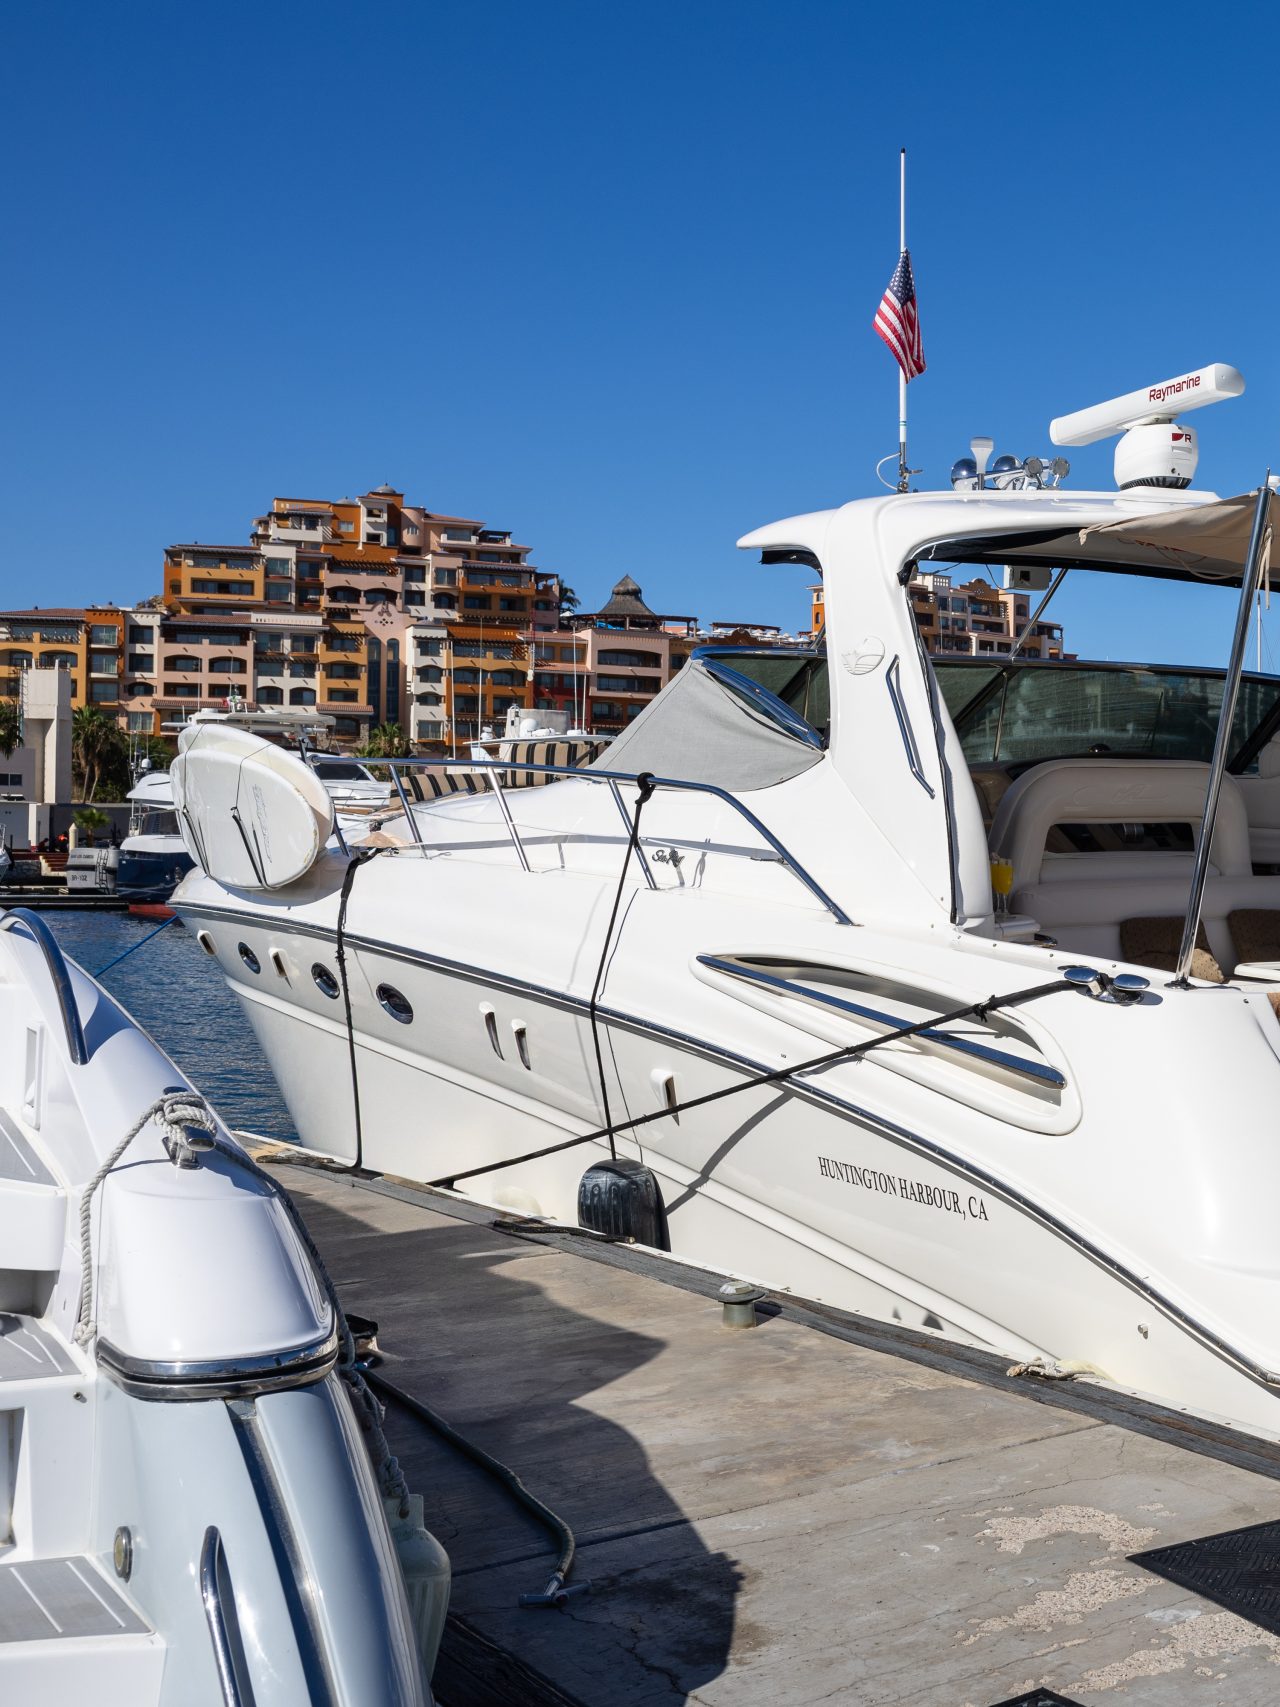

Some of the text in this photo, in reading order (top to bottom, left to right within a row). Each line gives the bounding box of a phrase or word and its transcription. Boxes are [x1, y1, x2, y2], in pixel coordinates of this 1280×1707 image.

[1149, 375, 1201, 402] Raymarine
[818, 1156, 990, 1222] HUNTINGTON HARBOUR, CA
